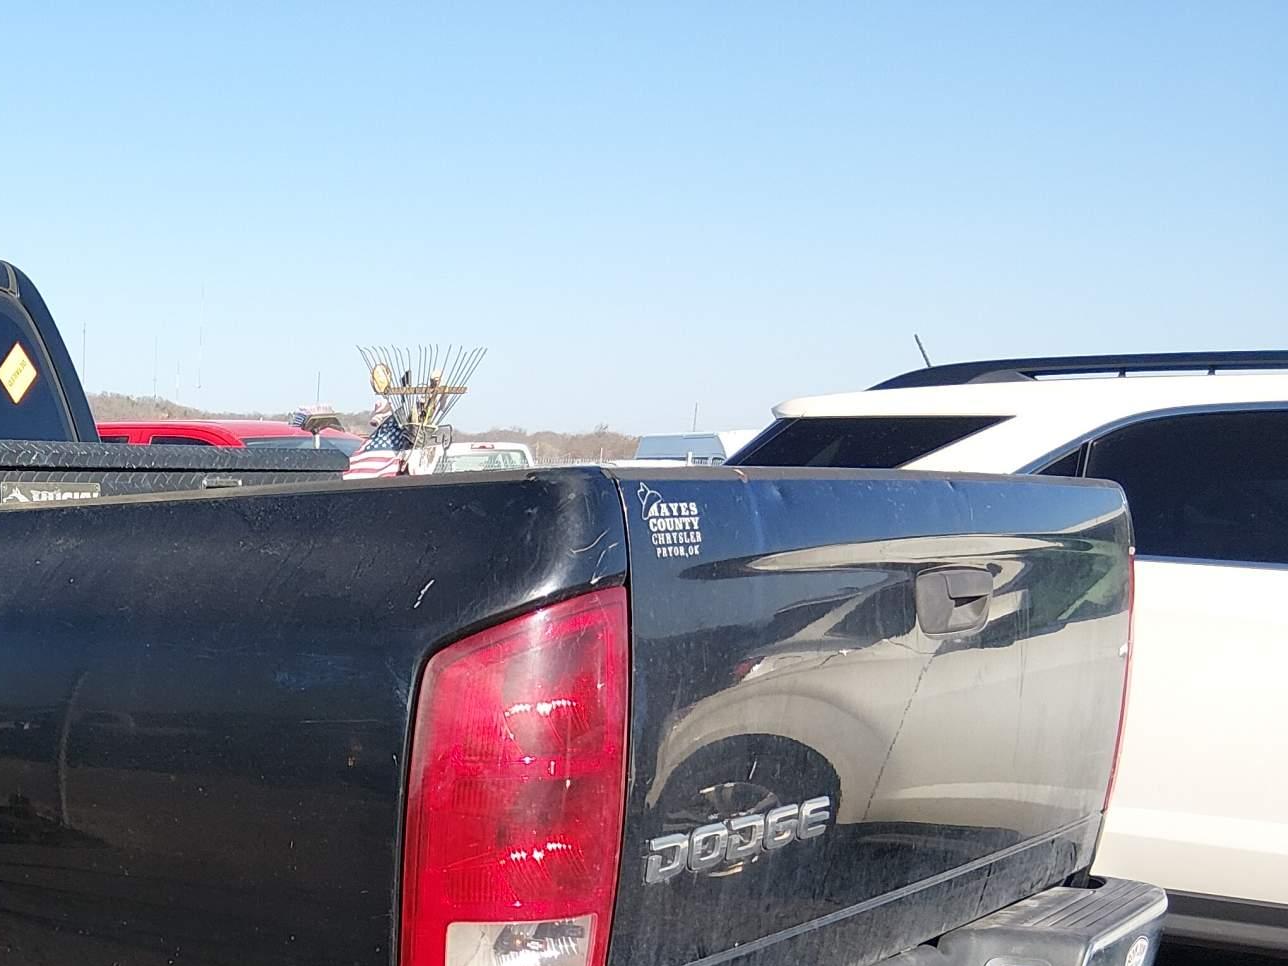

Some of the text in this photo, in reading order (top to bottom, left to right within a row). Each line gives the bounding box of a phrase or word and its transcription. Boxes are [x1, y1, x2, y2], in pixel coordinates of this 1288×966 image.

[649, 517, 700, 532] COUNTY
[651, 531, 702, 545] CHRYSLER
[643, 796, 830, 884] DODGE
